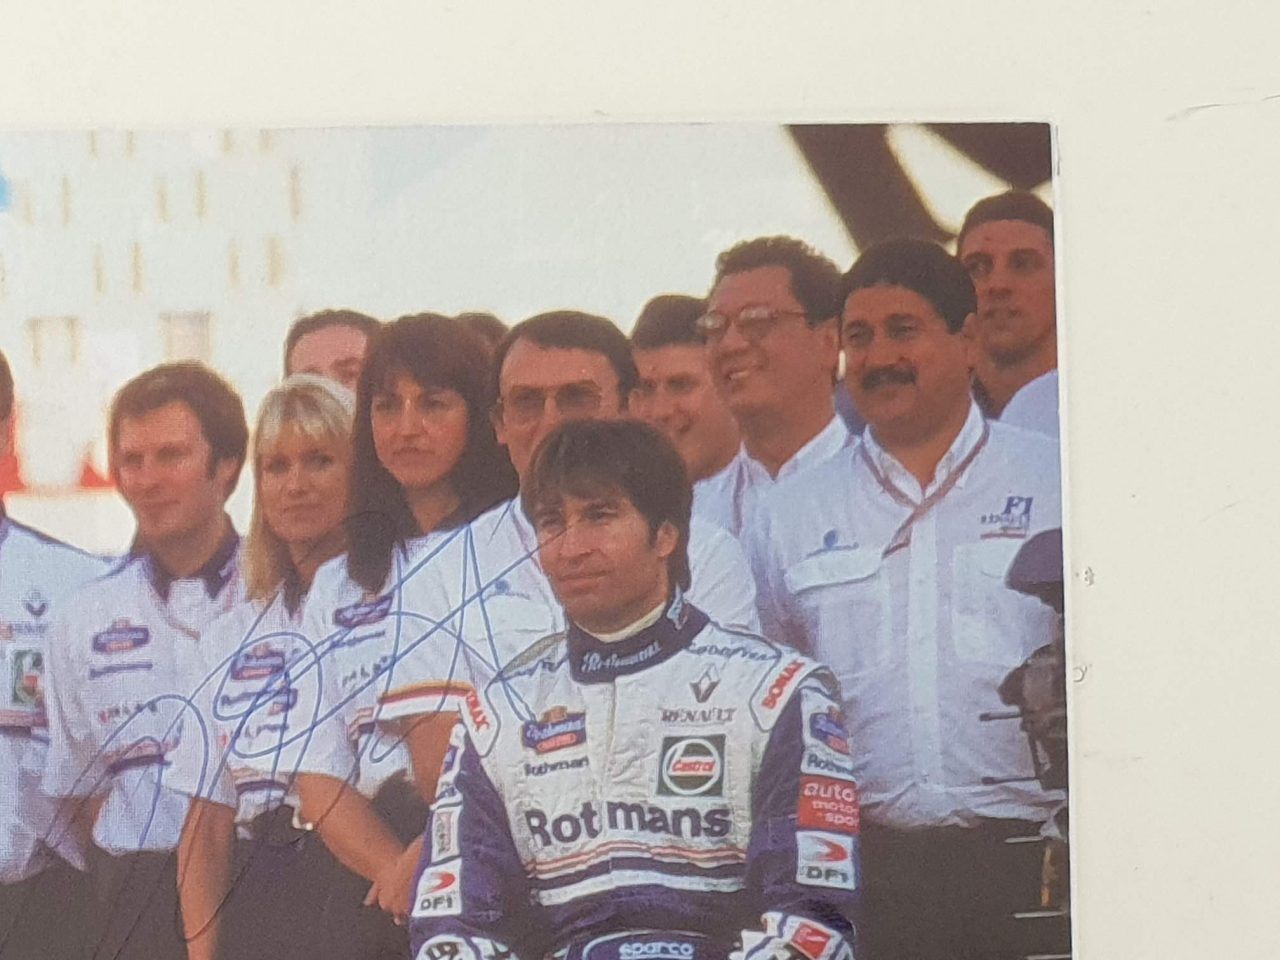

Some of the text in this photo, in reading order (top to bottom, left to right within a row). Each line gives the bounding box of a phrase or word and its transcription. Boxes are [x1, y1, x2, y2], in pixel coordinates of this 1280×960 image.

[761, 659, 806, 710] SONAX
[661, 707, 737, 723] RENAULT
[671, 758, 715, 773] Castrol
[804, 782, 856, 802] auto
[524, 801, 735, 848] Rotmans
[421, 895, 453, 911] DF1
[620, 941, 695, 959] sparco
